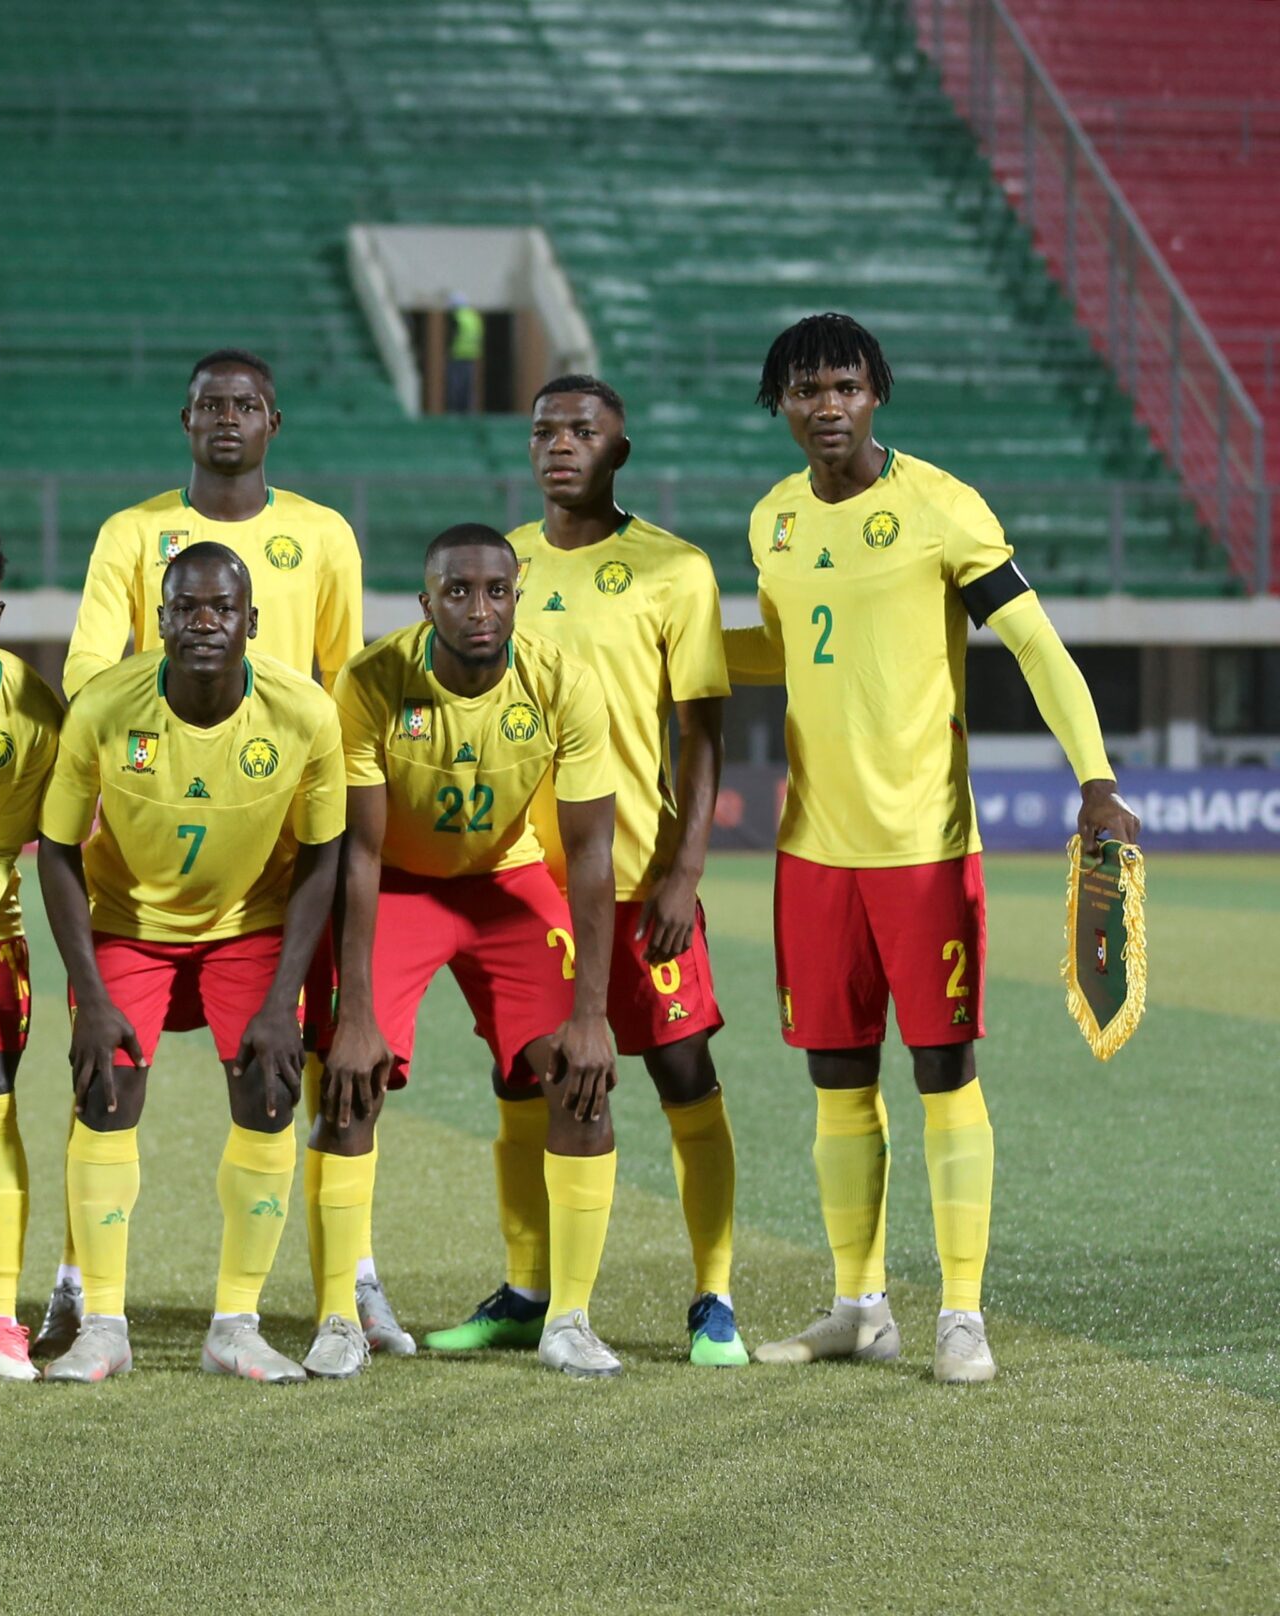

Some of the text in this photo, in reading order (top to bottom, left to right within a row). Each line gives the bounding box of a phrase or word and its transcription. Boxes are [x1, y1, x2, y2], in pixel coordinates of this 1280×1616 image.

[812, 604, 835, 664] 2
[435, 784, 494, 832] 22
[176, 824, 208, 875] 7
[942, 940, 968, 998] 2
